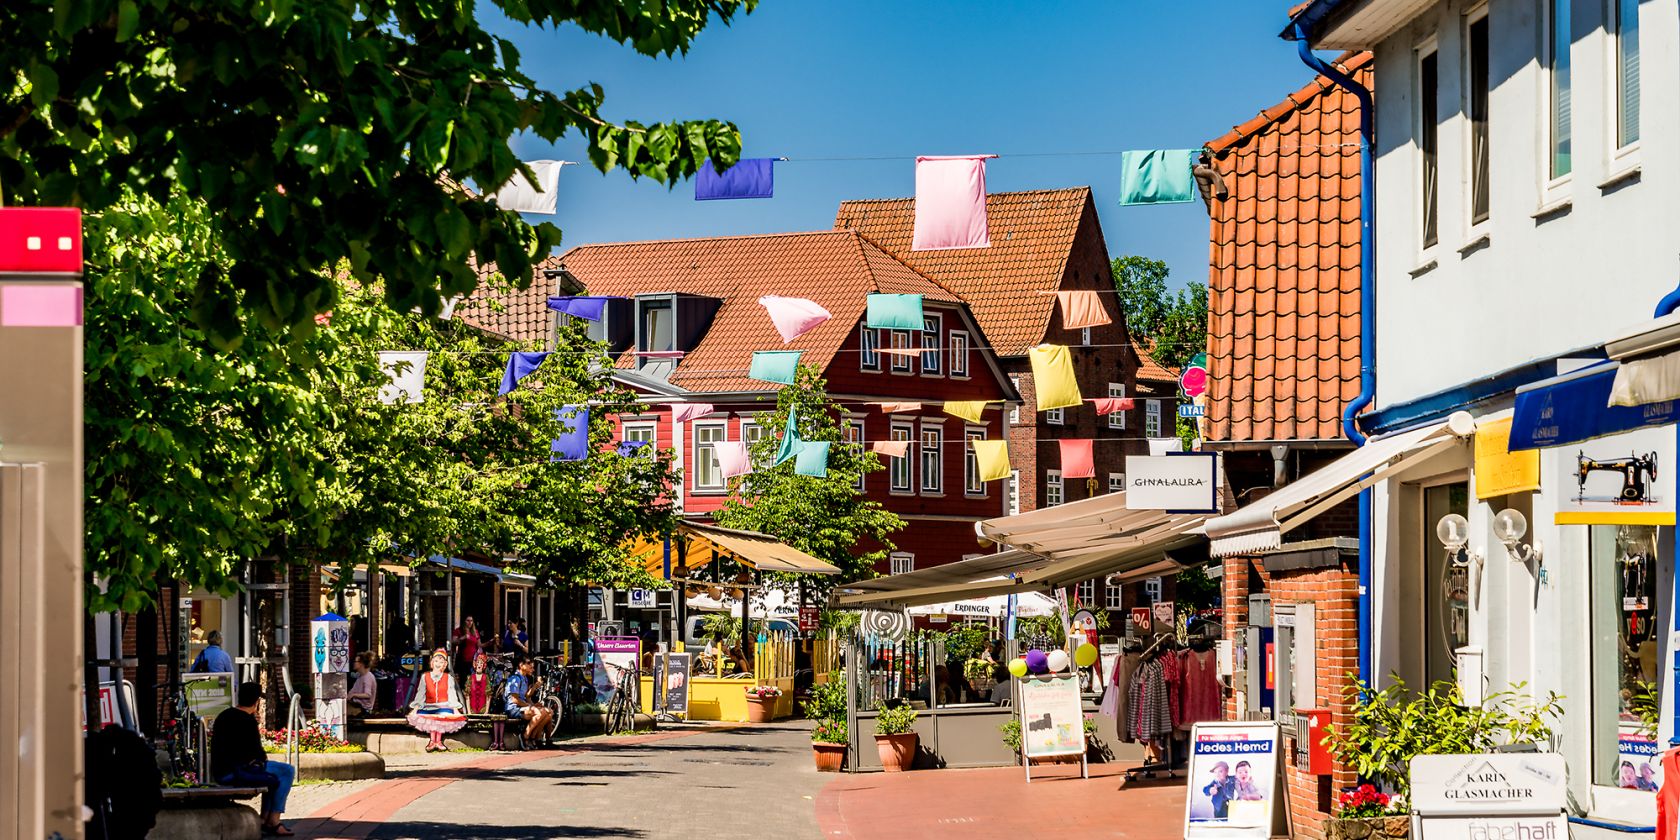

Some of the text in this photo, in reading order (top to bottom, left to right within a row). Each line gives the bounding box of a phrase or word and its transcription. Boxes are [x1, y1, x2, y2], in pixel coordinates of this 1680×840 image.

[954, 603, 990, 614] ERDINGER
[1197, 742, 1269, 753] Jedes Hemd
[1467, 773, 1507, 783] KARIN
[1444, 788, 1533, 800] GLASMACHER
